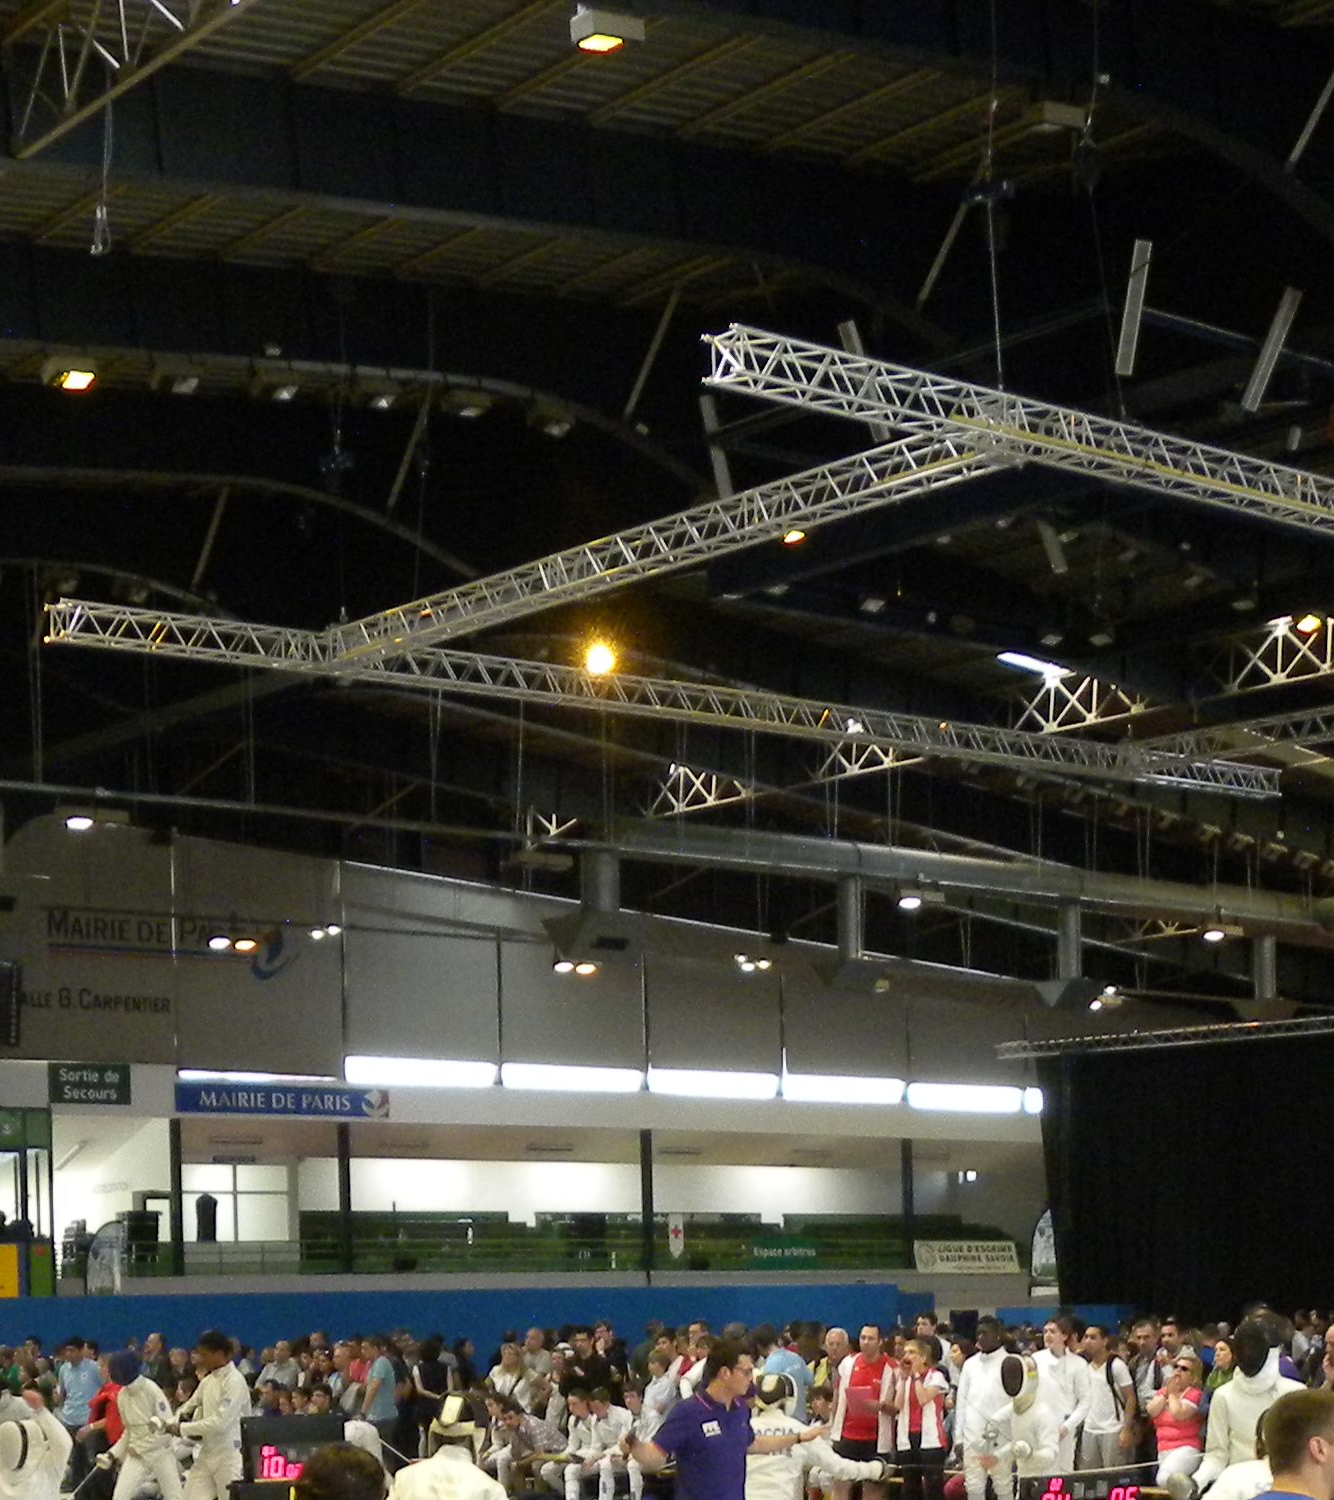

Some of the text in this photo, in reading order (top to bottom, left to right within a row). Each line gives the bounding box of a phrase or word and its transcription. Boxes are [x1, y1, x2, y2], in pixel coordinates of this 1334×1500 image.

[47, 909, 132, 941] MAIRIE
[137, 916, 168, 944] DE
[59, 1067, 121, 1084] Sortie de
[63, 1085, 118, 1101] Secours
[198, 1090, 351, 1111] MAIRIE DE PARIS
[753, 1246, 783, 1258] Espace
[938, 1243, 1014, 1254] LIGUE D'ESCRIME
[985, 1253, 1016, 1263] SAVOIE
